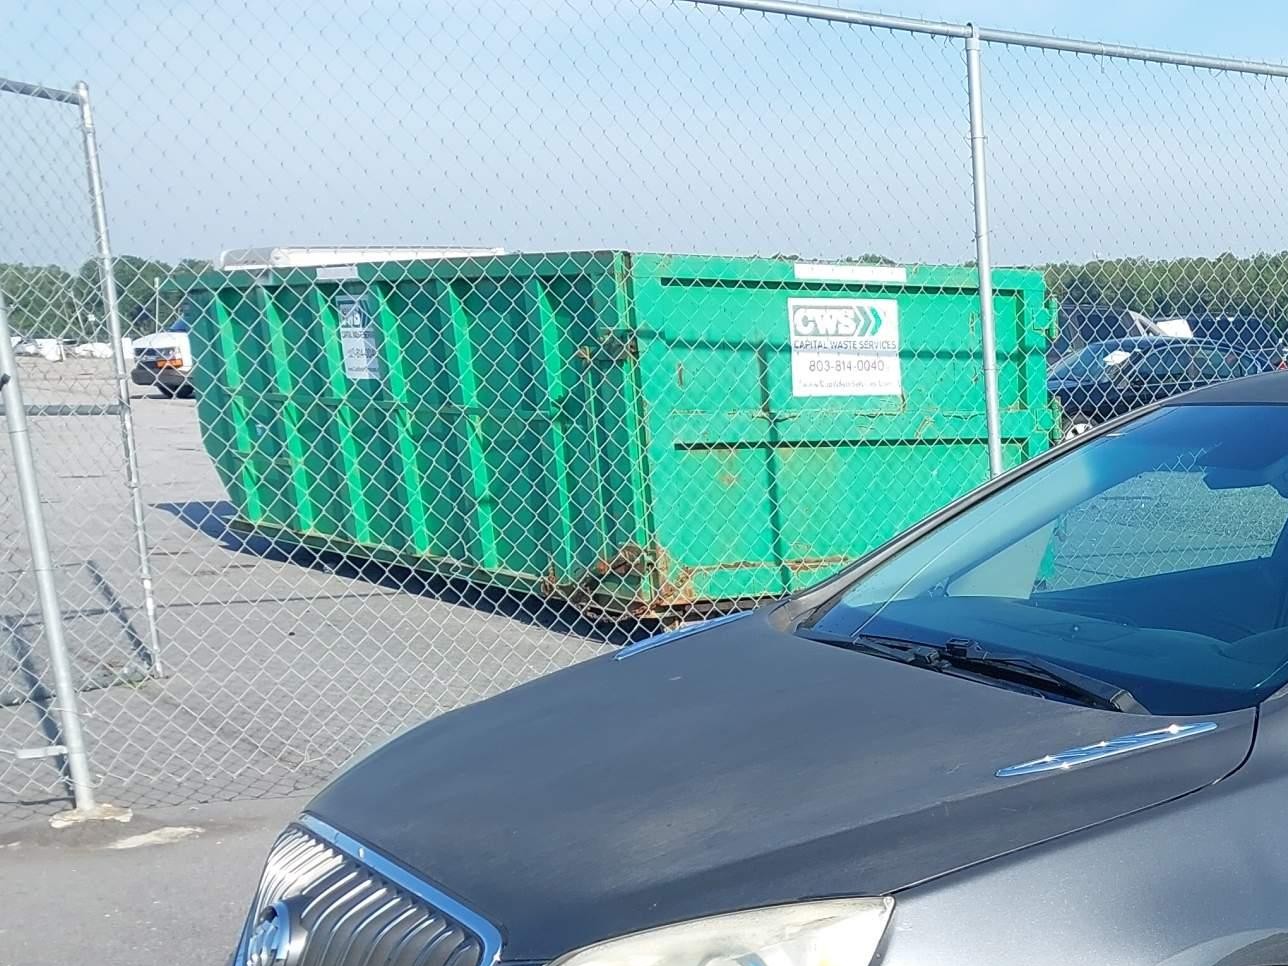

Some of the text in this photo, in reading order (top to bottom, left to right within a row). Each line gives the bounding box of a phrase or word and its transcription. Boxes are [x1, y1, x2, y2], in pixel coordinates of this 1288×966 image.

[793, 306, 858, 336] CWS
[793, 340, 897, 350] CAPITAL WASTE SERVICES
[808, 359, 885, 372] 803-814-0040
